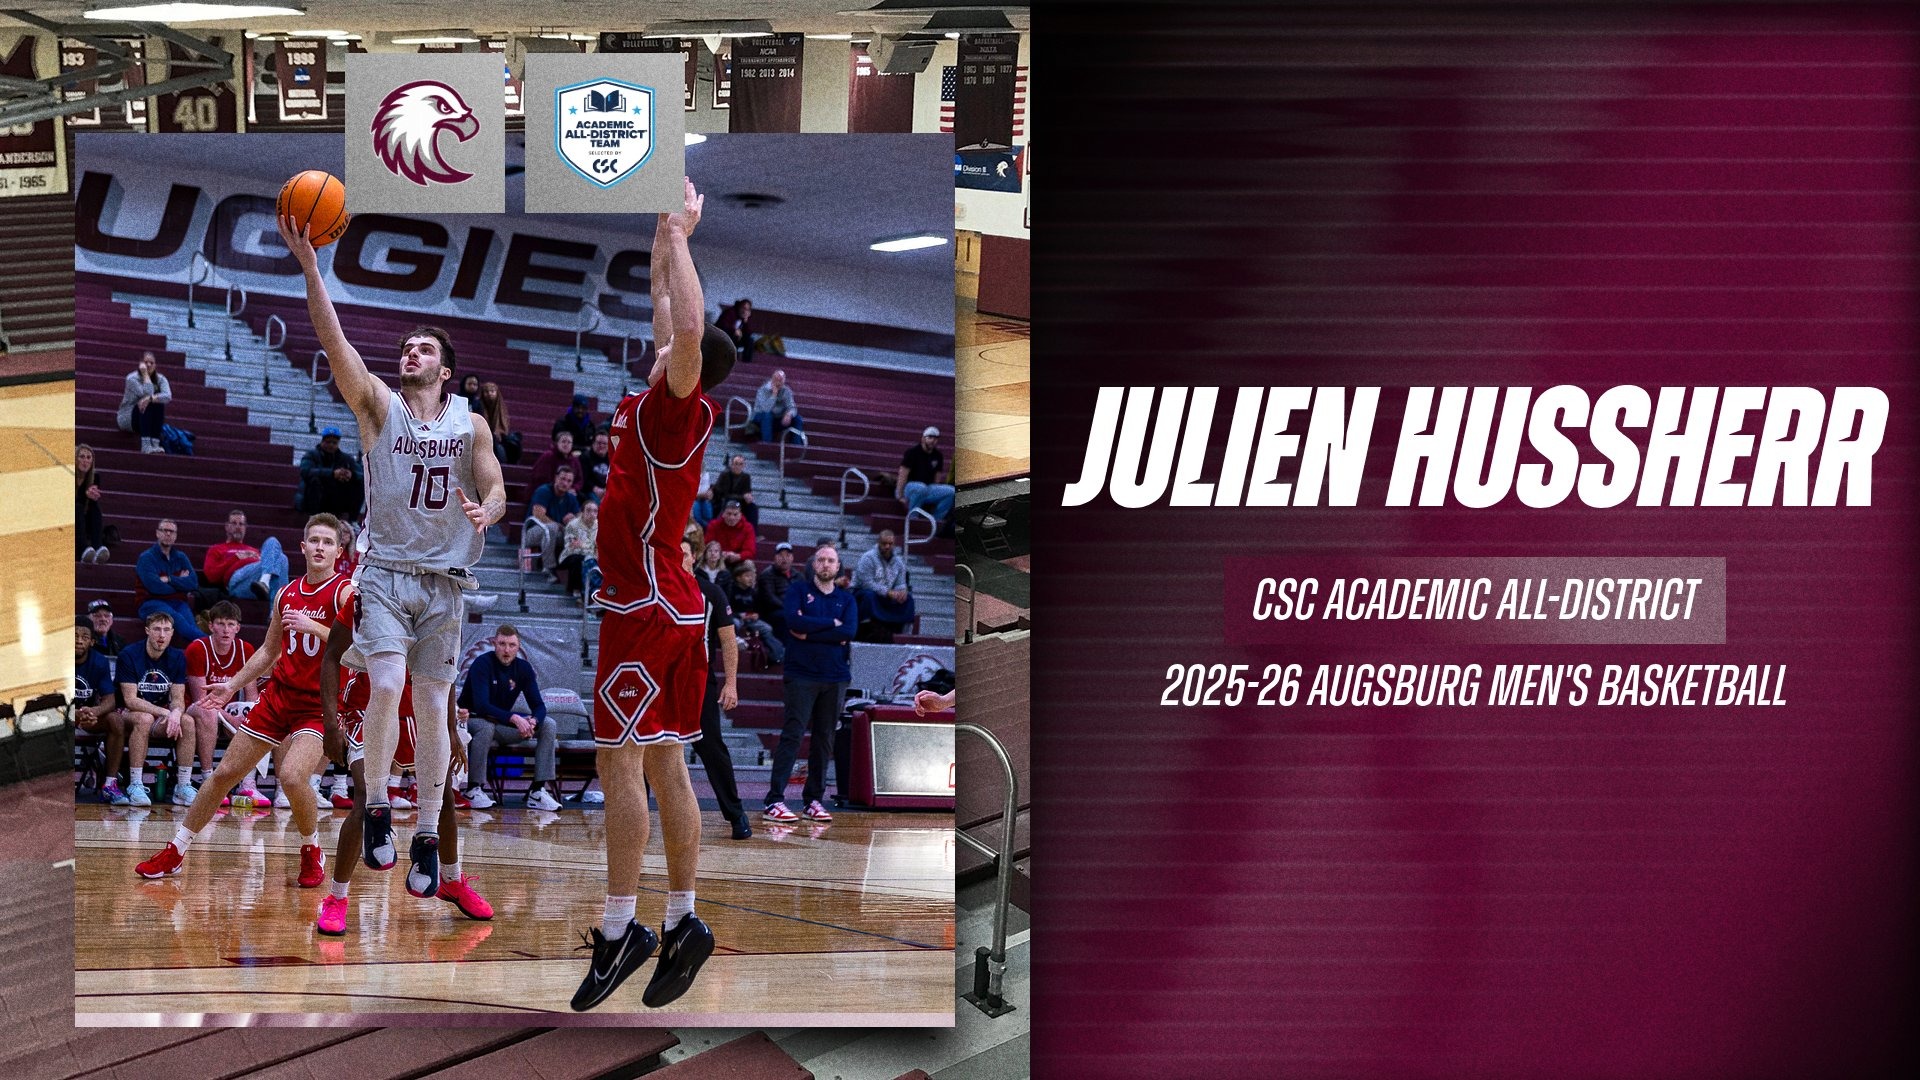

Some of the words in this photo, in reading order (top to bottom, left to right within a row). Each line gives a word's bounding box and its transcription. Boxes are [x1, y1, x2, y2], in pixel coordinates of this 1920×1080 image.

[759, 68, 776, 78] 2013
[778, 68, 796, 78] 2014
[173, 95, 218, 132] 40
[408, 464, 450, 511] 10
[287, 629, 321, 657] 30
